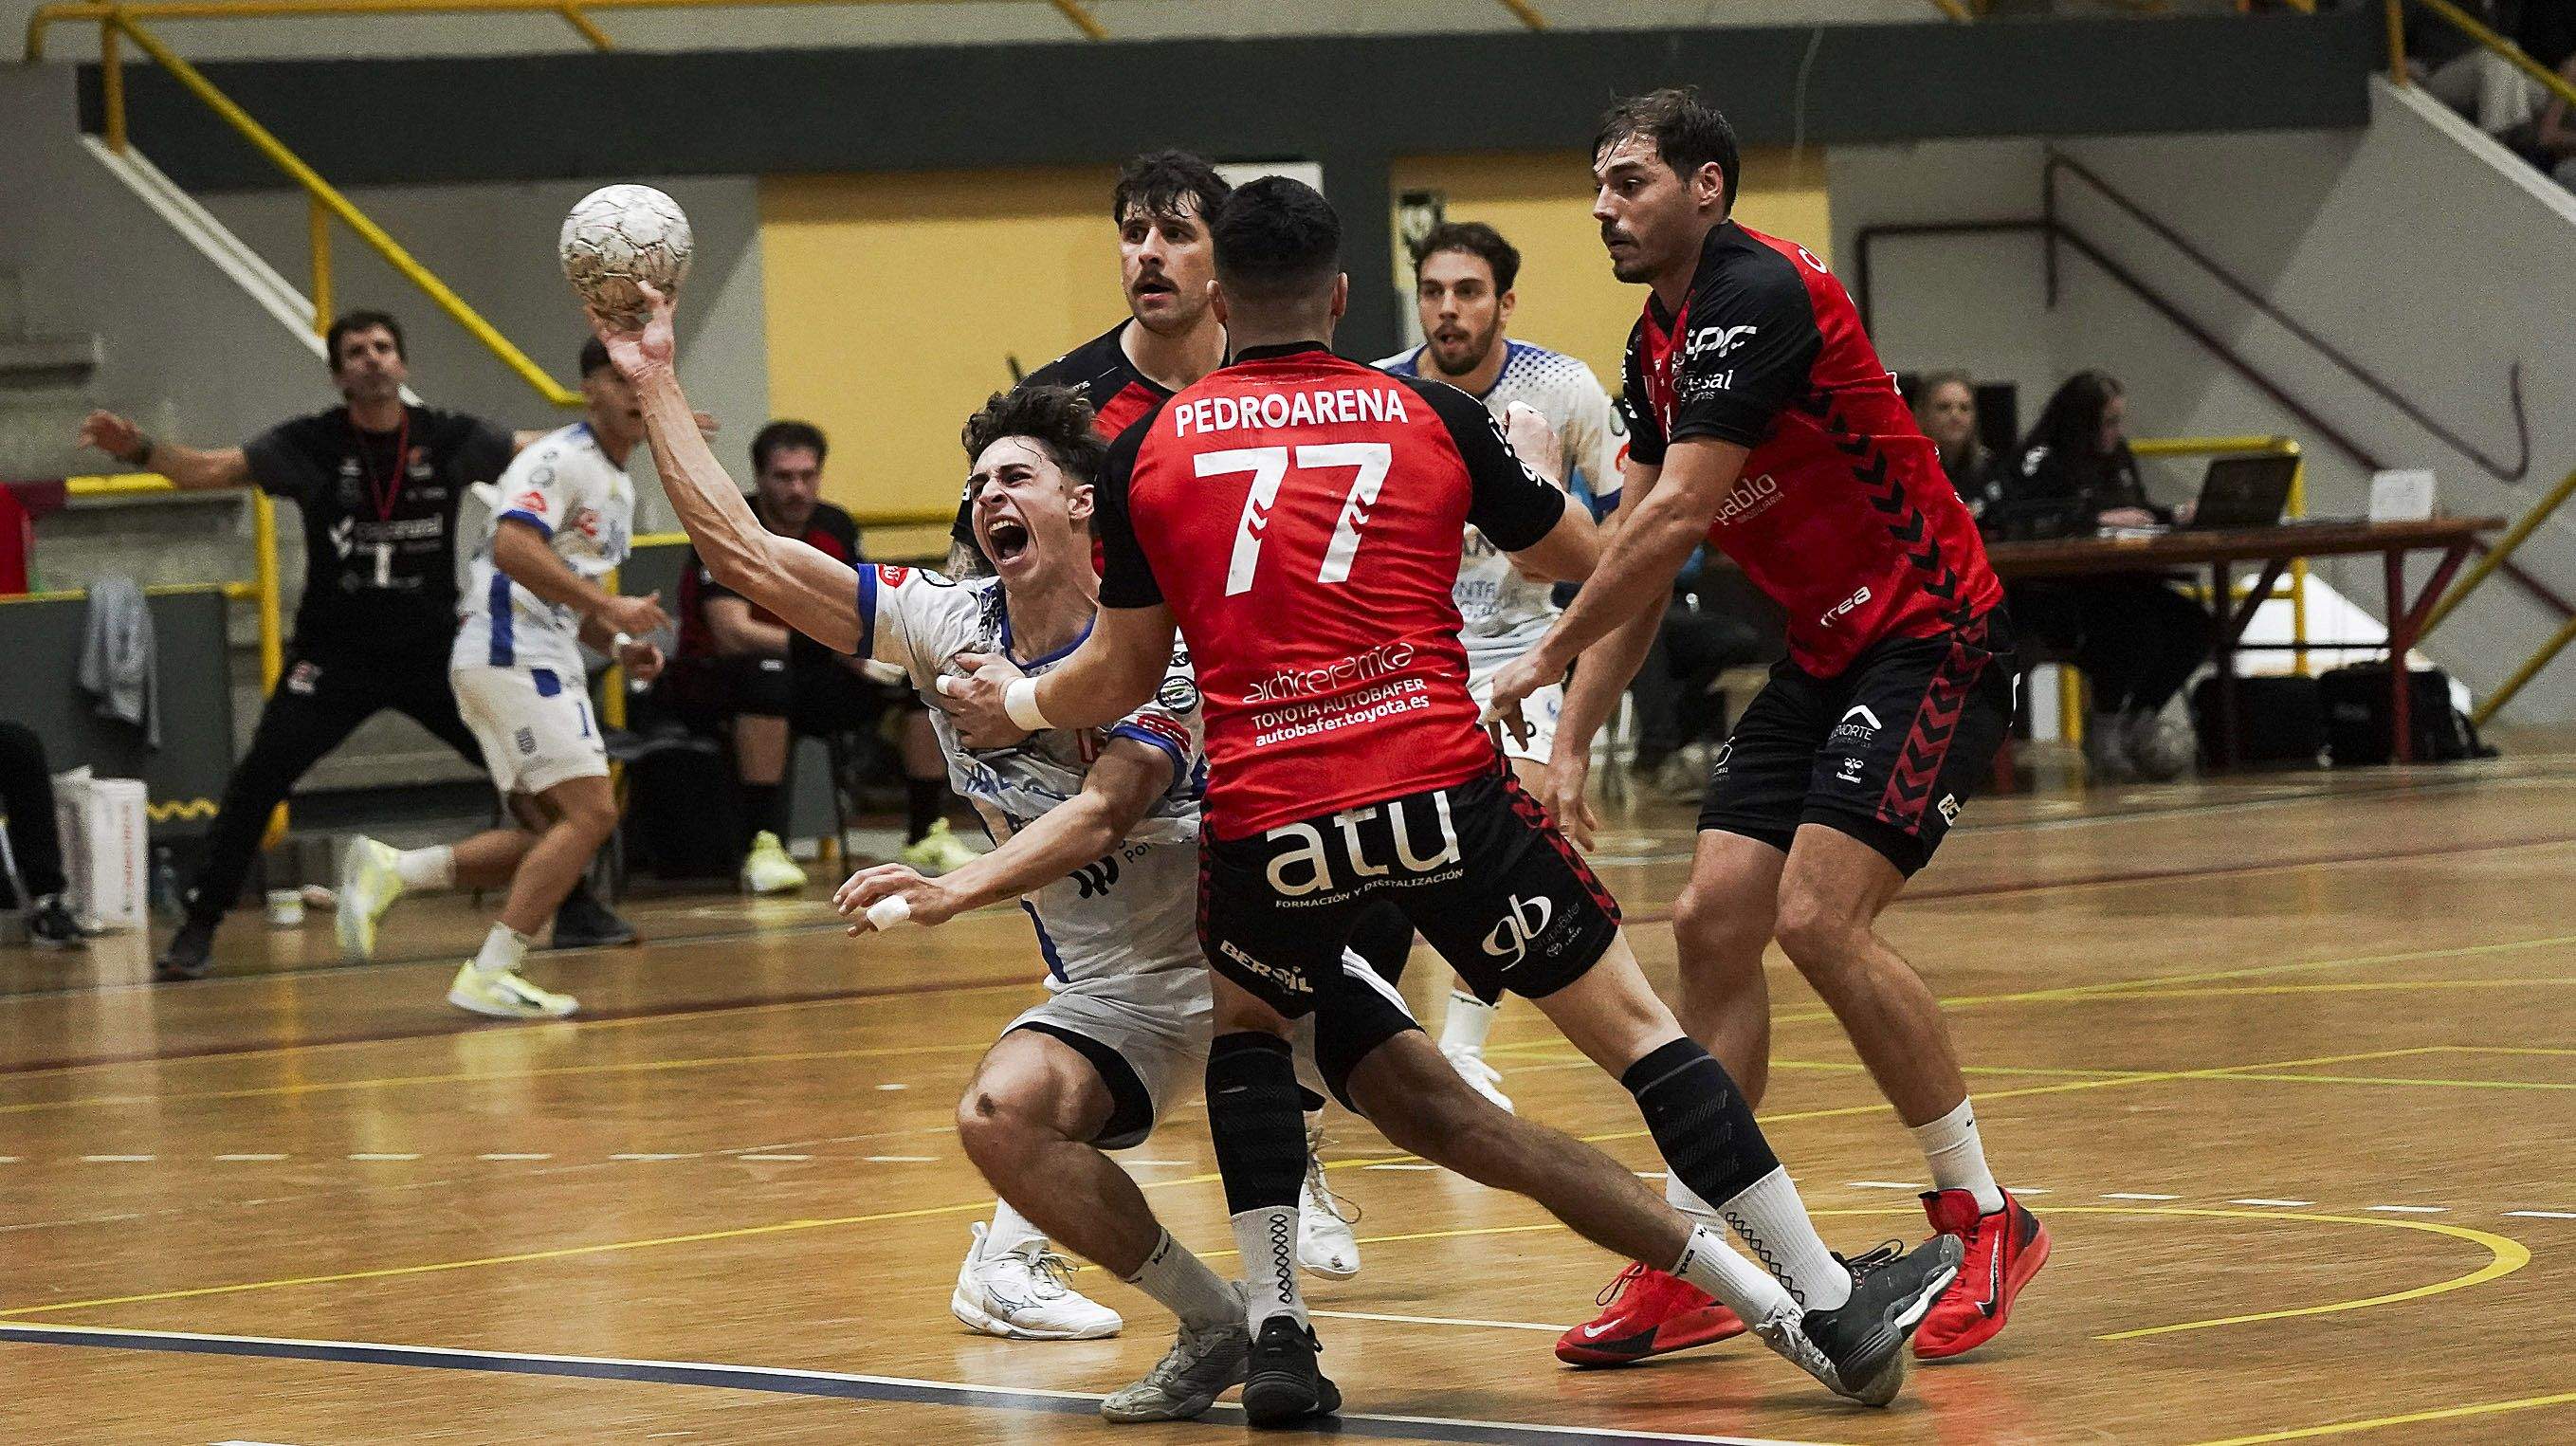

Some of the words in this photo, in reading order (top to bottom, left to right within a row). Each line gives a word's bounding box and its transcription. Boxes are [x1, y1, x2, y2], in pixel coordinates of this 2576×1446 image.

[1175, 388, 1409, 438] PEDROARENA
[1193, 442, 1393, 597] 77
[1251, 702, 1320, 730] TOYOTA
[1324, 678, 1428, 713] AUTOBAFER
[1254, 693, 1430, 747] autobafer.toyota.es
[1266, 790, 1461, 896] atu
[1275, 891, 1350, 908] FORMACIÓN
[1354, 888, 1362, 897] Y
[1482, 893, 1552, 972] gb
